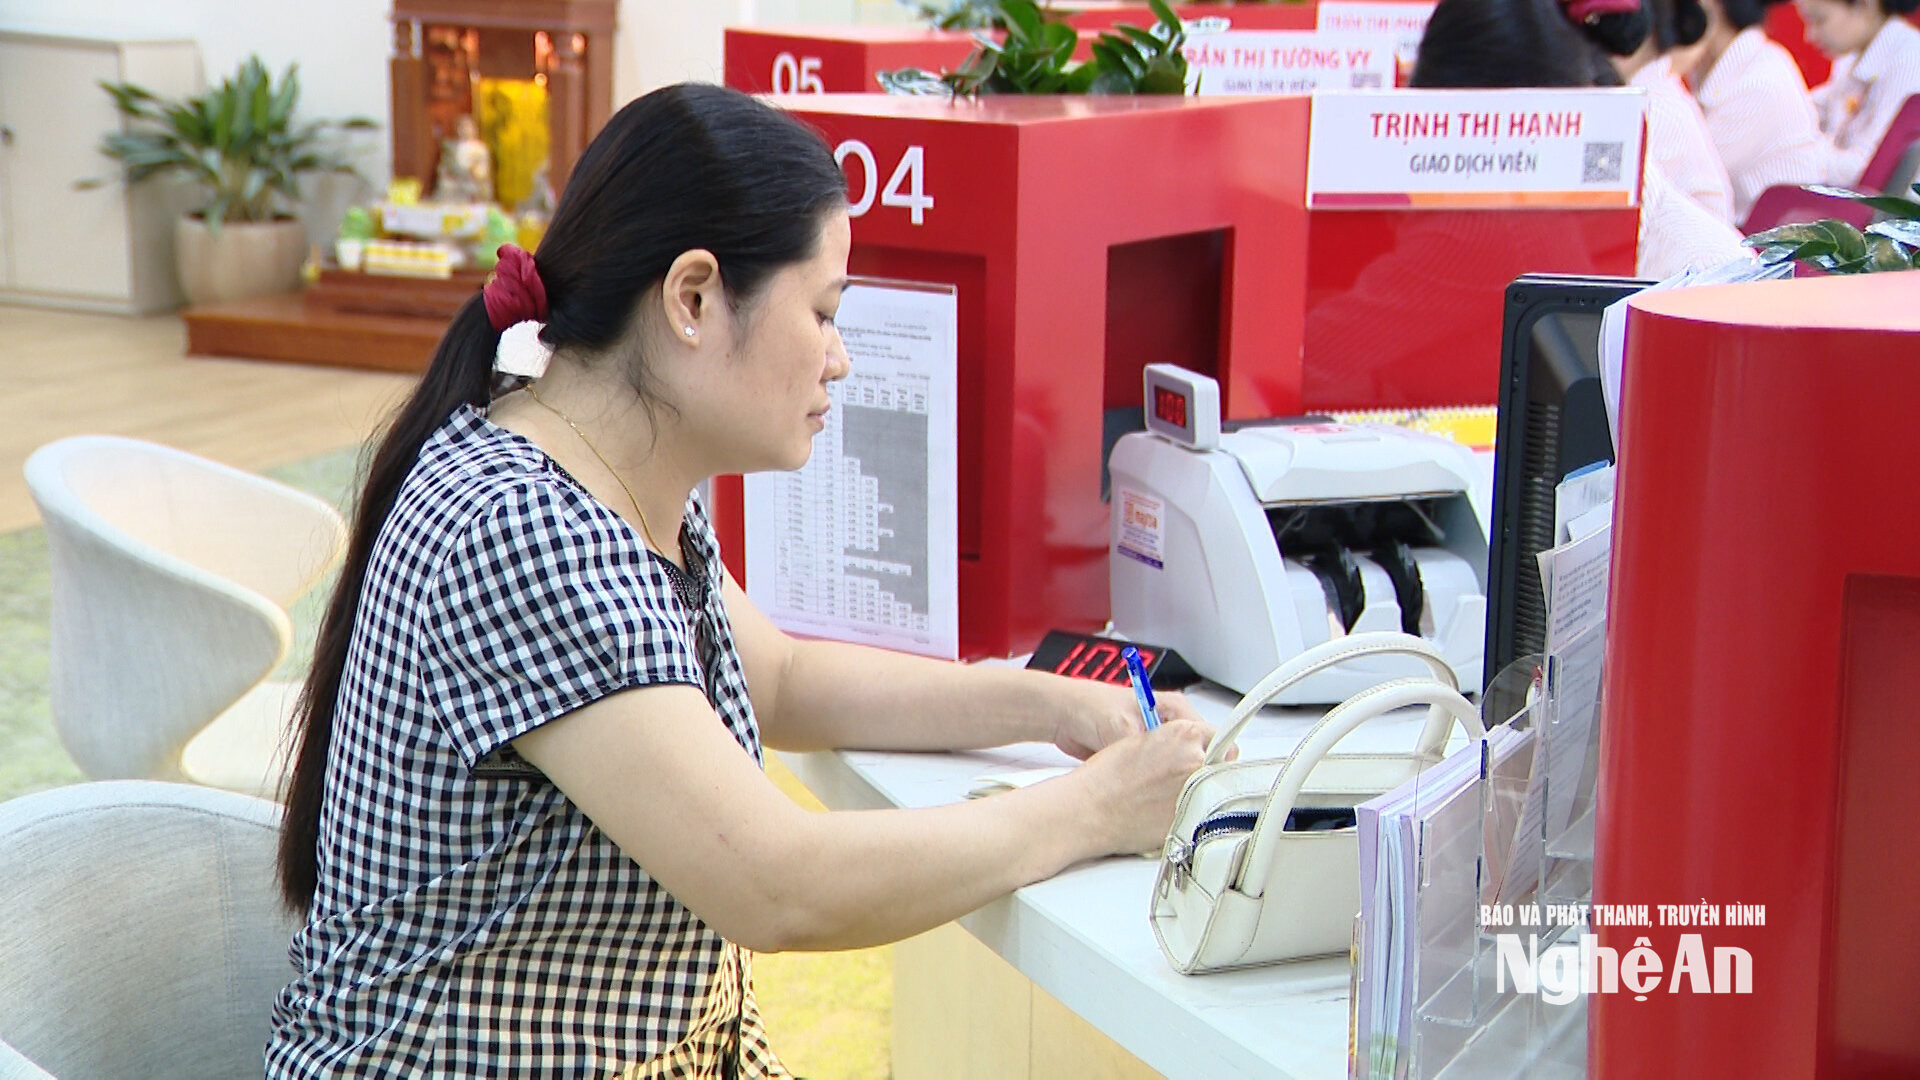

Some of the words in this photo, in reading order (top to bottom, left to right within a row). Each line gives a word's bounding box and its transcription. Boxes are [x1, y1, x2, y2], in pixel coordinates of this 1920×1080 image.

[772, 52, 825, 95] 05
[1346, 47, 1371, 68] VY
[1370, 112, 1449, 145] TRỊNH
[1457, 112, 1500, 144] THỊ
[1508, 112, 1582, 144] HẠNH
[1410, 153, 1450, 173] GIAO
[1454, 153, 1494, 178] DỊCH
[1499, 150, 1539, 173] VIÊN
[834, 139, 934, 225] 04
